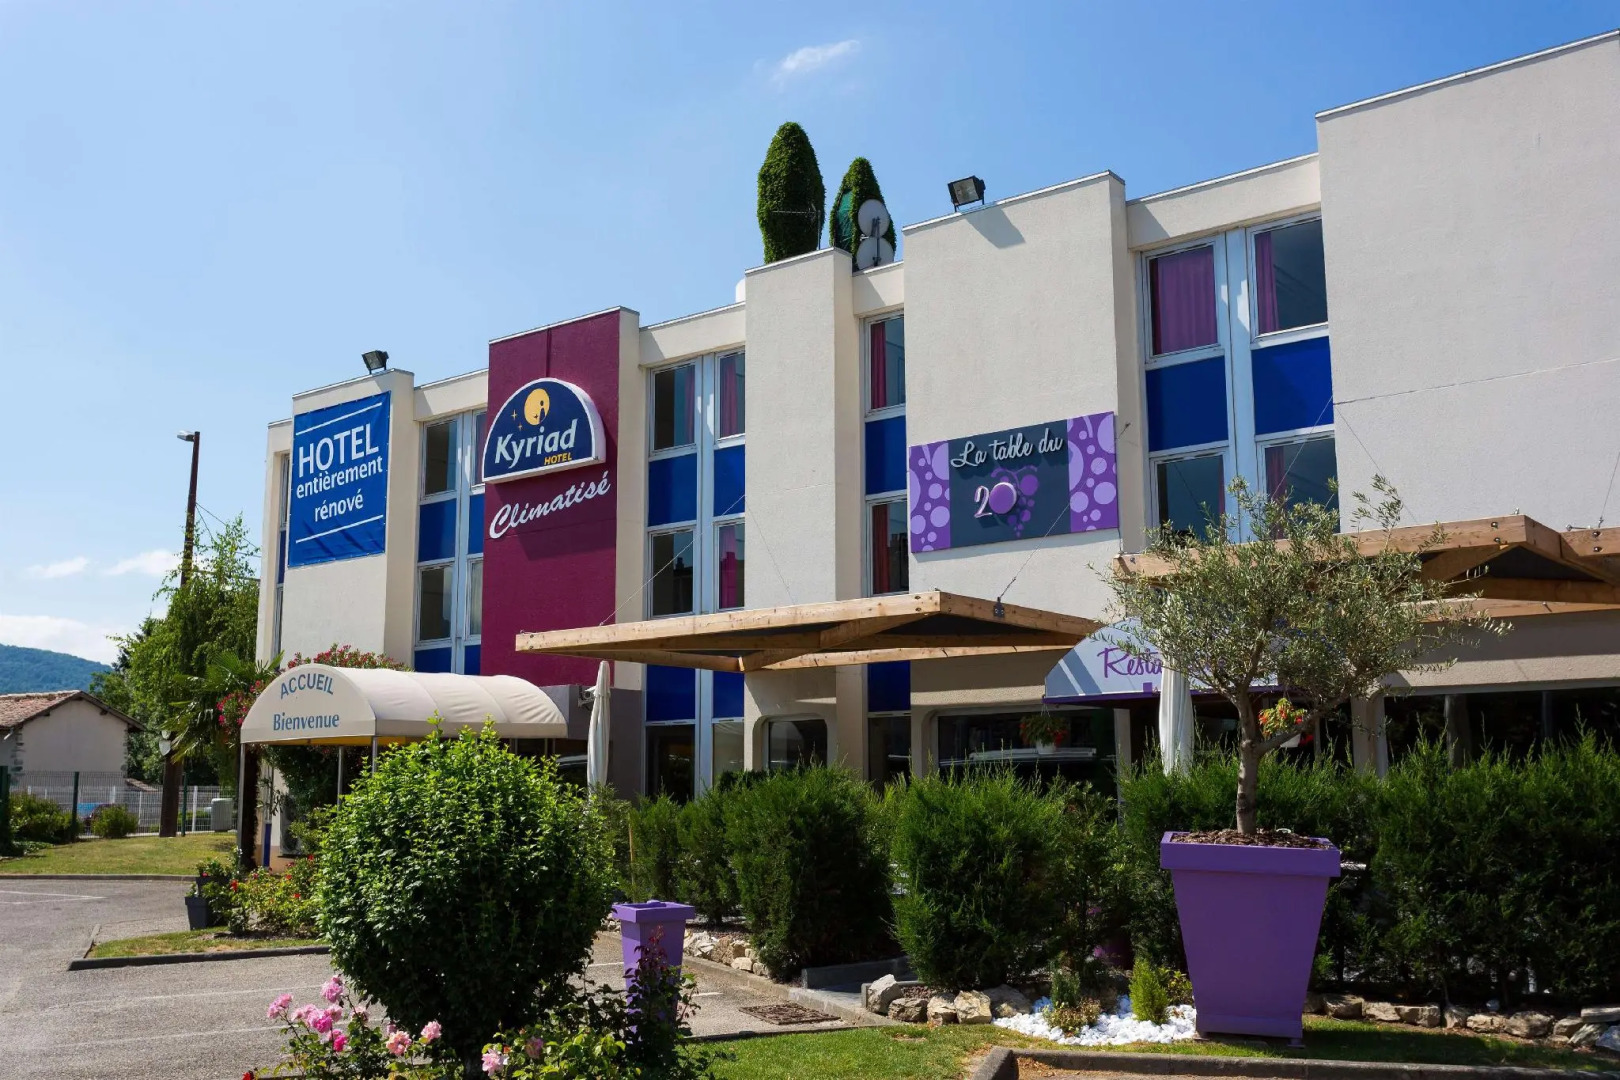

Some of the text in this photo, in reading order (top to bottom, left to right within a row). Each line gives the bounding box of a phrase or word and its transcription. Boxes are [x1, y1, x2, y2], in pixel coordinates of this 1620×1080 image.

[298, 423, 379, 478] HOTEL
[495, 418, 577, 469] Kyriad
[544, 452, 572, 466] HOTEL
[951, 428, 1063, 468] La table du
[296, 455, 383, 499] entièrement
[314, 488, 364, 522] rénové
[489, 470, 611, 539] Climatisé
[1097, 647, 1162, 678] Resta
[280, 673, 334, 700] ACCUEIL
[273, 711, 340, 732] Bienvenue
